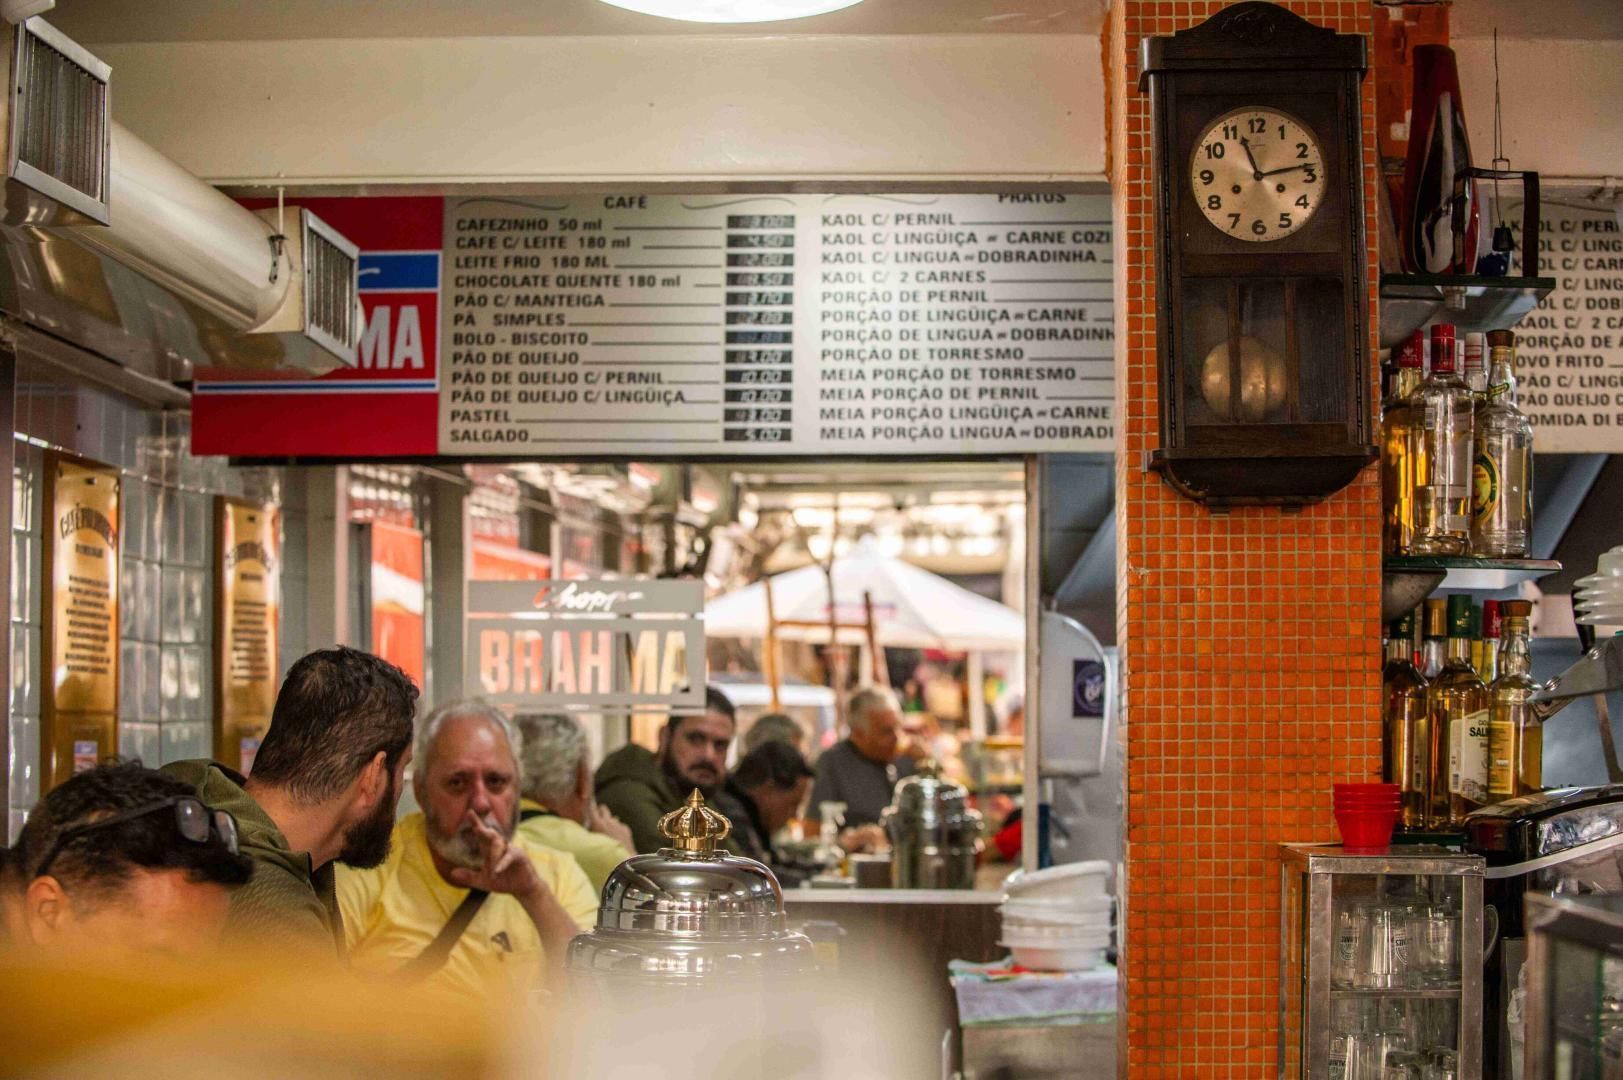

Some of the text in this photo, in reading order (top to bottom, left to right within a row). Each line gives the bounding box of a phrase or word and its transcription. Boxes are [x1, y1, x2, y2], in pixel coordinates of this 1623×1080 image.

[1223, 125, 1237, 139] 11
[1248, 118, 1266, 133] 12
[1278, 125, 1285, 139] 1
[1205, 142, 1224, 159] 10
[1296, 143, 1308, 158] 2
[1200, 170, 1214, 185] 9
[1304, 168, 1317, 183] 3
[1208, 195, 1221, 210] 8
[1295, 195, 1309, 208] 4
[456, 219, 548, 231] CAFEZINHO
[559, 219, 577, 231] 50
[583, 219, 601, 231] ml
[822, 213, 955, 226] KAOL C/ PERNIL
[1228, 214, 1240, 229] 7
[1279, 213, 1291, 228] 5
[1511, 221, 1554, 232] KOL
[1560, 220, 1577, 232] C/
[1252, 220, 1266, 235] 6
[503, 237, 519, 249] C/
[524, 237, 567, 249] LEITE
[579, 237, 605, 249] 180
[612, 237, 630, 249] ml
[822, 233, 865, 245] KAOL
[872, 233, 888, 245] C/
[1007, 231, 1065, 244] CARNE
[1072, 231, 1110, 244] COZI
[1513, 240, 1555, 251] KOL
[1561, 240, 1578, 251] C/
[455, 256, 497, 268] LEITE
[504, 256, 540, 268] FRIO
[552, 256, 579, 268] 180
[585, 256, 609, 268] ML
[822, 252, 865, 264] KAOL
[872, 252, 888, 264] C/
[894, 251, 960, 263] LINGUA
[978, 250, 1096, 263] DOBRADINHA
[1513, 259, 1555, 269] KOL
[1562, 258, 1578, 270] C/
[455, 275, 680, 288] CHOCOLATE QUENTE 180 ml
[822, 271, 985, 284] KAOL C/ 2 CARNES
[1563, 278, 1580, 290] C/
[494, 295, 510, 307] C/
[515, 295, 604, 307] MANTEIGA
[900, 291, 920, 303] DE
[928, 290, 988, 302] PERNIL
[1563, 297, 1580, 310] C/
[1586, 298, 1623, 310] DOB
[493, 313, 565, 326] SIMPLES
[900, 310, 920, 321] DE
[1028, 309, 1088, 322] CARNE
[1565, 317, 1582, 329] C/
[1592, 317, 1600, 328] 2
[453, 333, 495, 346] BOLO
[512, 333, 588, 345] BISCOITO
[900, 330, 920, 341] DE
[927, 329, 992, 341] LINGUA
[1592, 336, 1612, 348] DE
[492, 352, 512, 365] DE
[519, 352, 579, 364] QUEIJO
[900, 349, 920, 361] DE
[928, 348, 1024, 360] TORRESMO
[1516, 355, 1603, 367] OVO FRITO
[492, 372, 512, 384] DE
[519, 371, 578, 384] QUEIJO
[585, 371, 601, 384] C/
[606, 371, 664, 384] PERNIL
[820, 369, 865, 381] MEIA
[951, 369, 972, 380] DE
[980, 368, 1076, 380] TORRESMO
[1557, 375, 1576, 388] C/
[491, 391, 511, 403] DE
[518, 391, 577, 403] QUEIJO
[584, 391, 600, 403] C/
[820, 389, 865, 401] MEIA
[950, 388, 971, 400] DE
[979, 388, 1040, 400] PERNIL
[1554, 394, 1609, 406] QUEIJO
[451, 410, 511, 422] PASTEL
[820, 408, 865, 420] MEIA
[1051, 407, 1110, 420] CARNE
[1528, 414, 1586, 426] OMIDA
[1594, 414, 1610, 426] DI
[450, 430, 528, 442] SALGADO
[820, 428, 865, 440] MEIA
[950, 427, 1016, 439] LINGUA
[480, 630, 690, 695] BRAHMA
